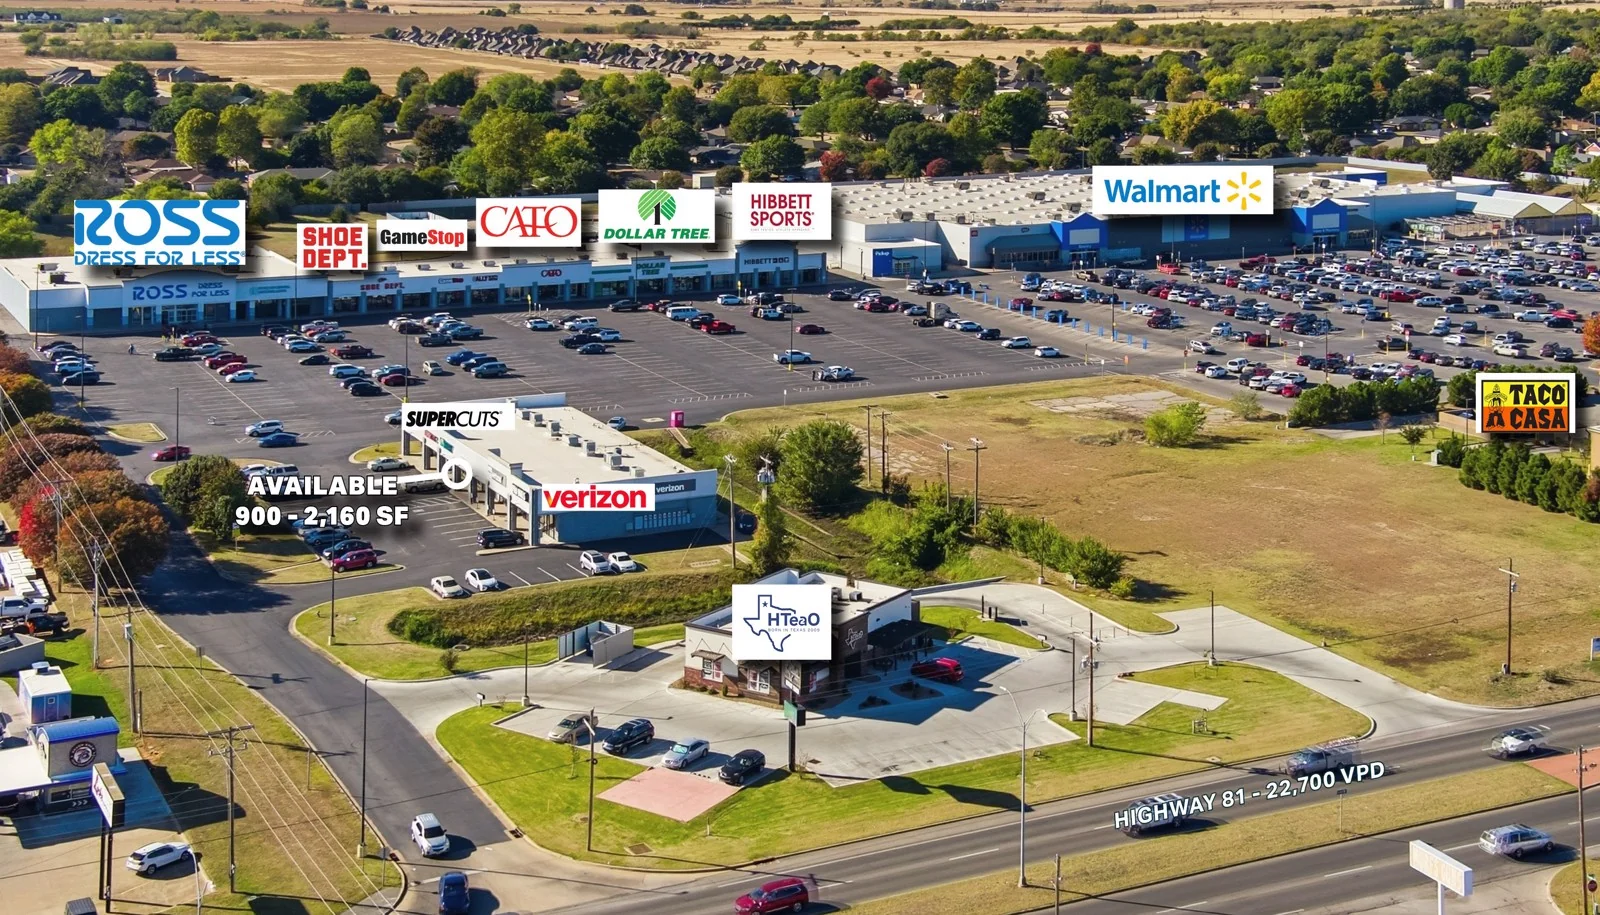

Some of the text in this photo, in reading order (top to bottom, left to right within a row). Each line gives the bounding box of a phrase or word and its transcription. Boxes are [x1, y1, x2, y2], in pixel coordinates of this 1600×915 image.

[541, 268, 562, 277] CATO
[133, 284, 188, 300] ROSS
[210, 289, 230, 297] LESS
[656, 483, 685, 494] verizon
